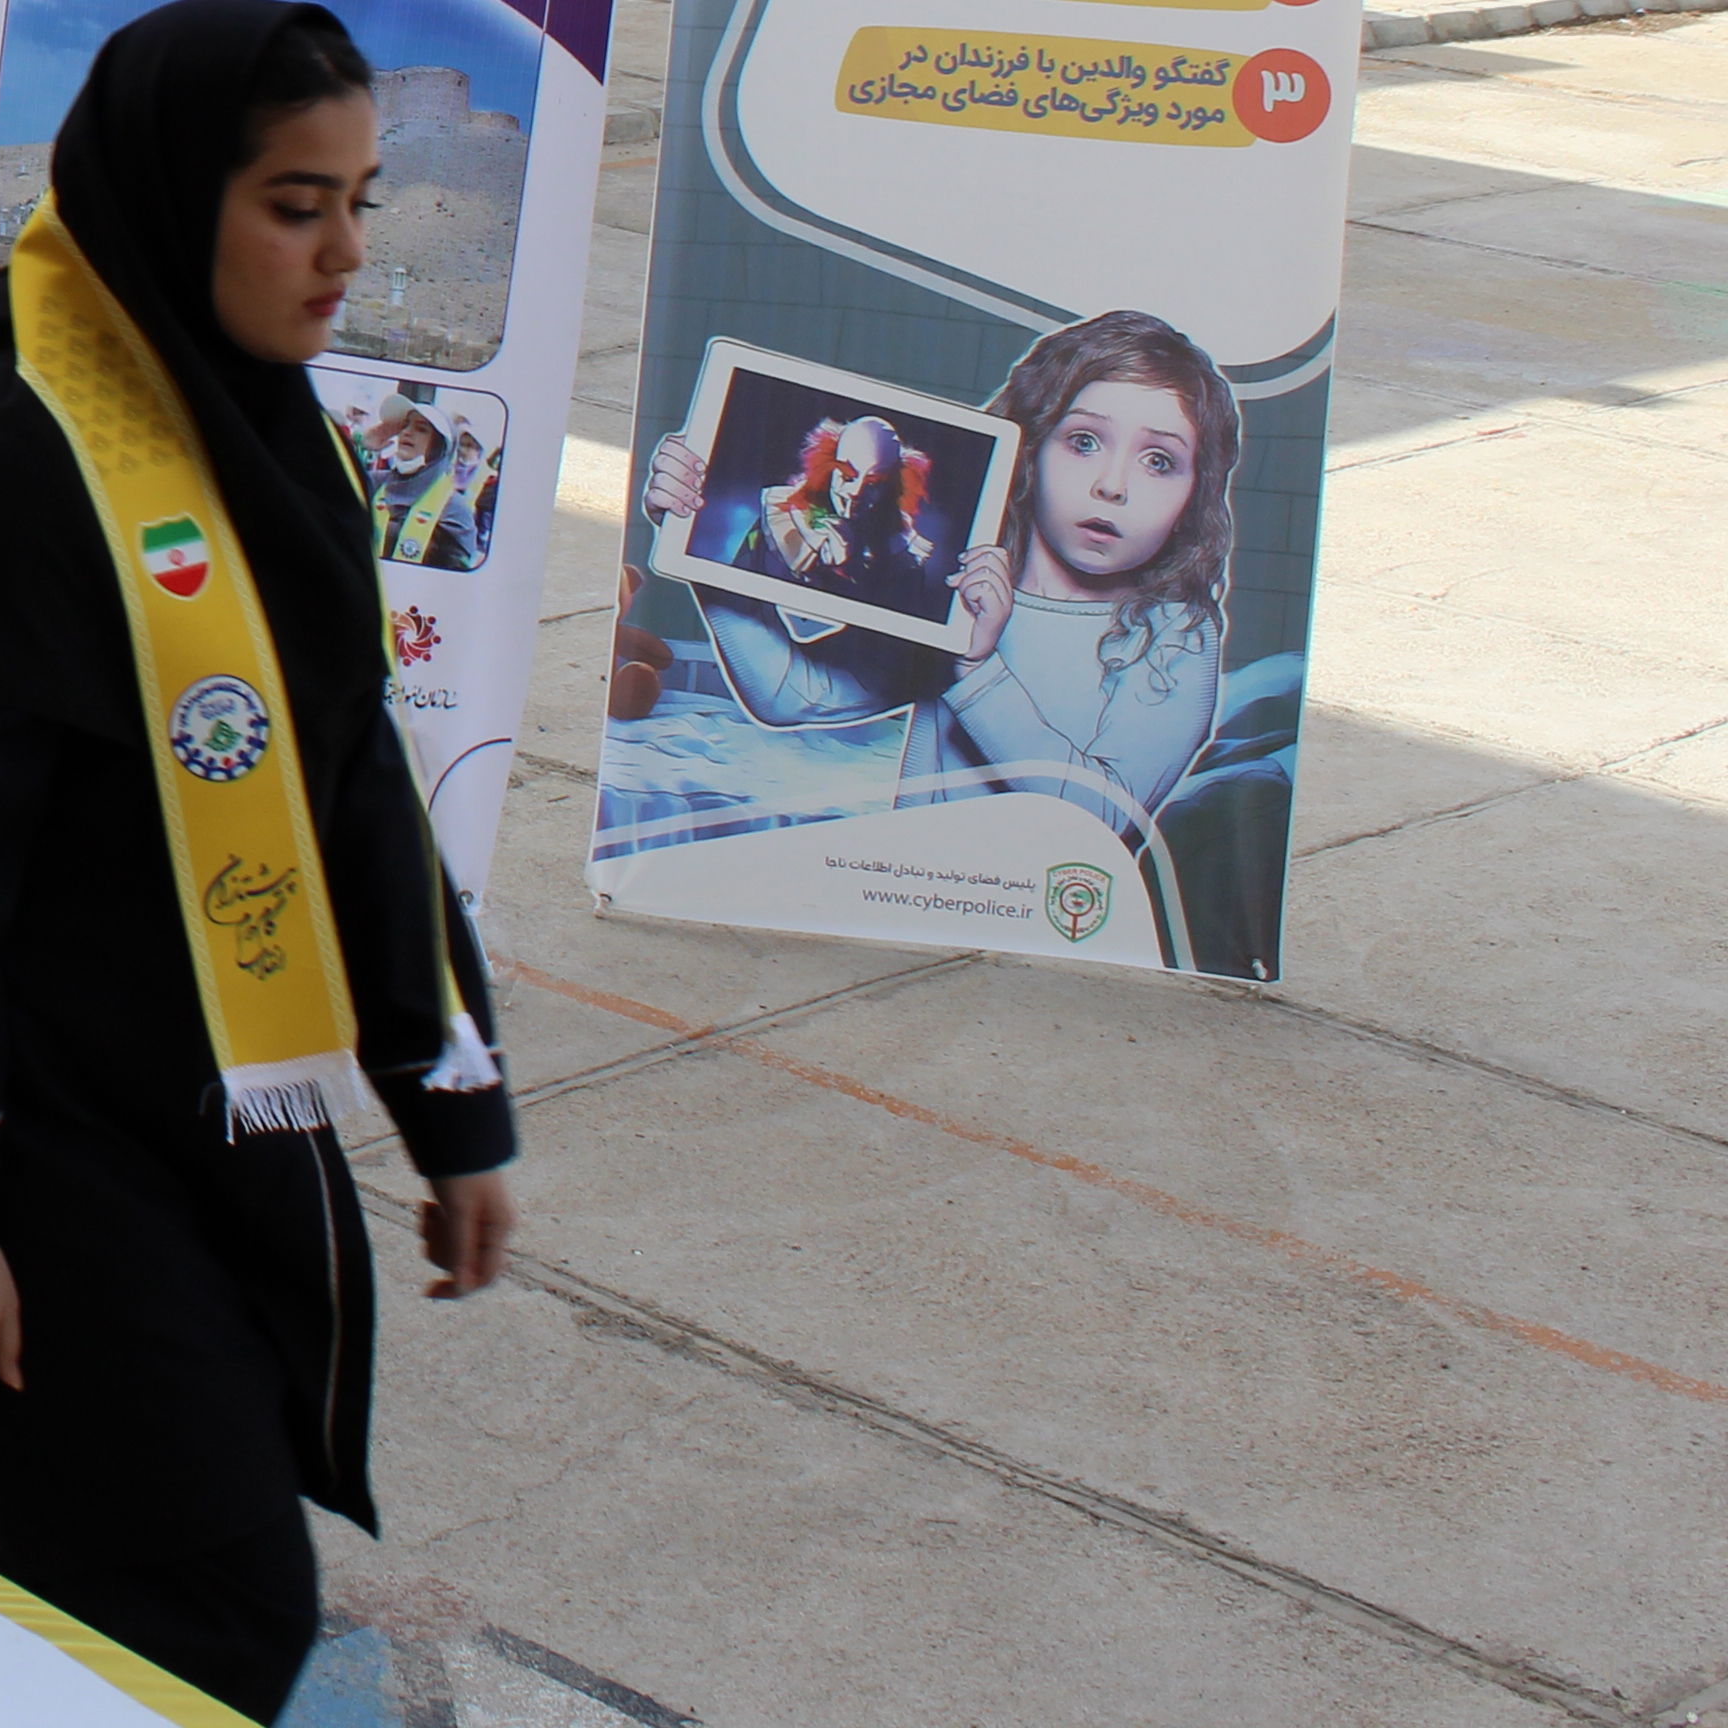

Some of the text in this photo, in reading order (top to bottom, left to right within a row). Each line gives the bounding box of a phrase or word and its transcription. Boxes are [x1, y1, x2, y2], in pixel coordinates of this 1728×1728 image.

[898, 43, 1231, 91] گفتگو والدین با فرزندان در
[847, 73, 937, 105] مجازی
[941, 79, 1019, 113] فضای
[1165, 99, 1225, 130] مورد
[825, 855, 847, 869] ناجا
[848, 859, 892, 873] اطلاعات
[893, 864, 925, 878] تبادل
[935, 870, 966, 884] تولید
[967, 873, 1001, 886] فضای
[1002, 876, 1037, 894] پلیس
[861, 887, 1034, 921] www.cyberpolice.ir
